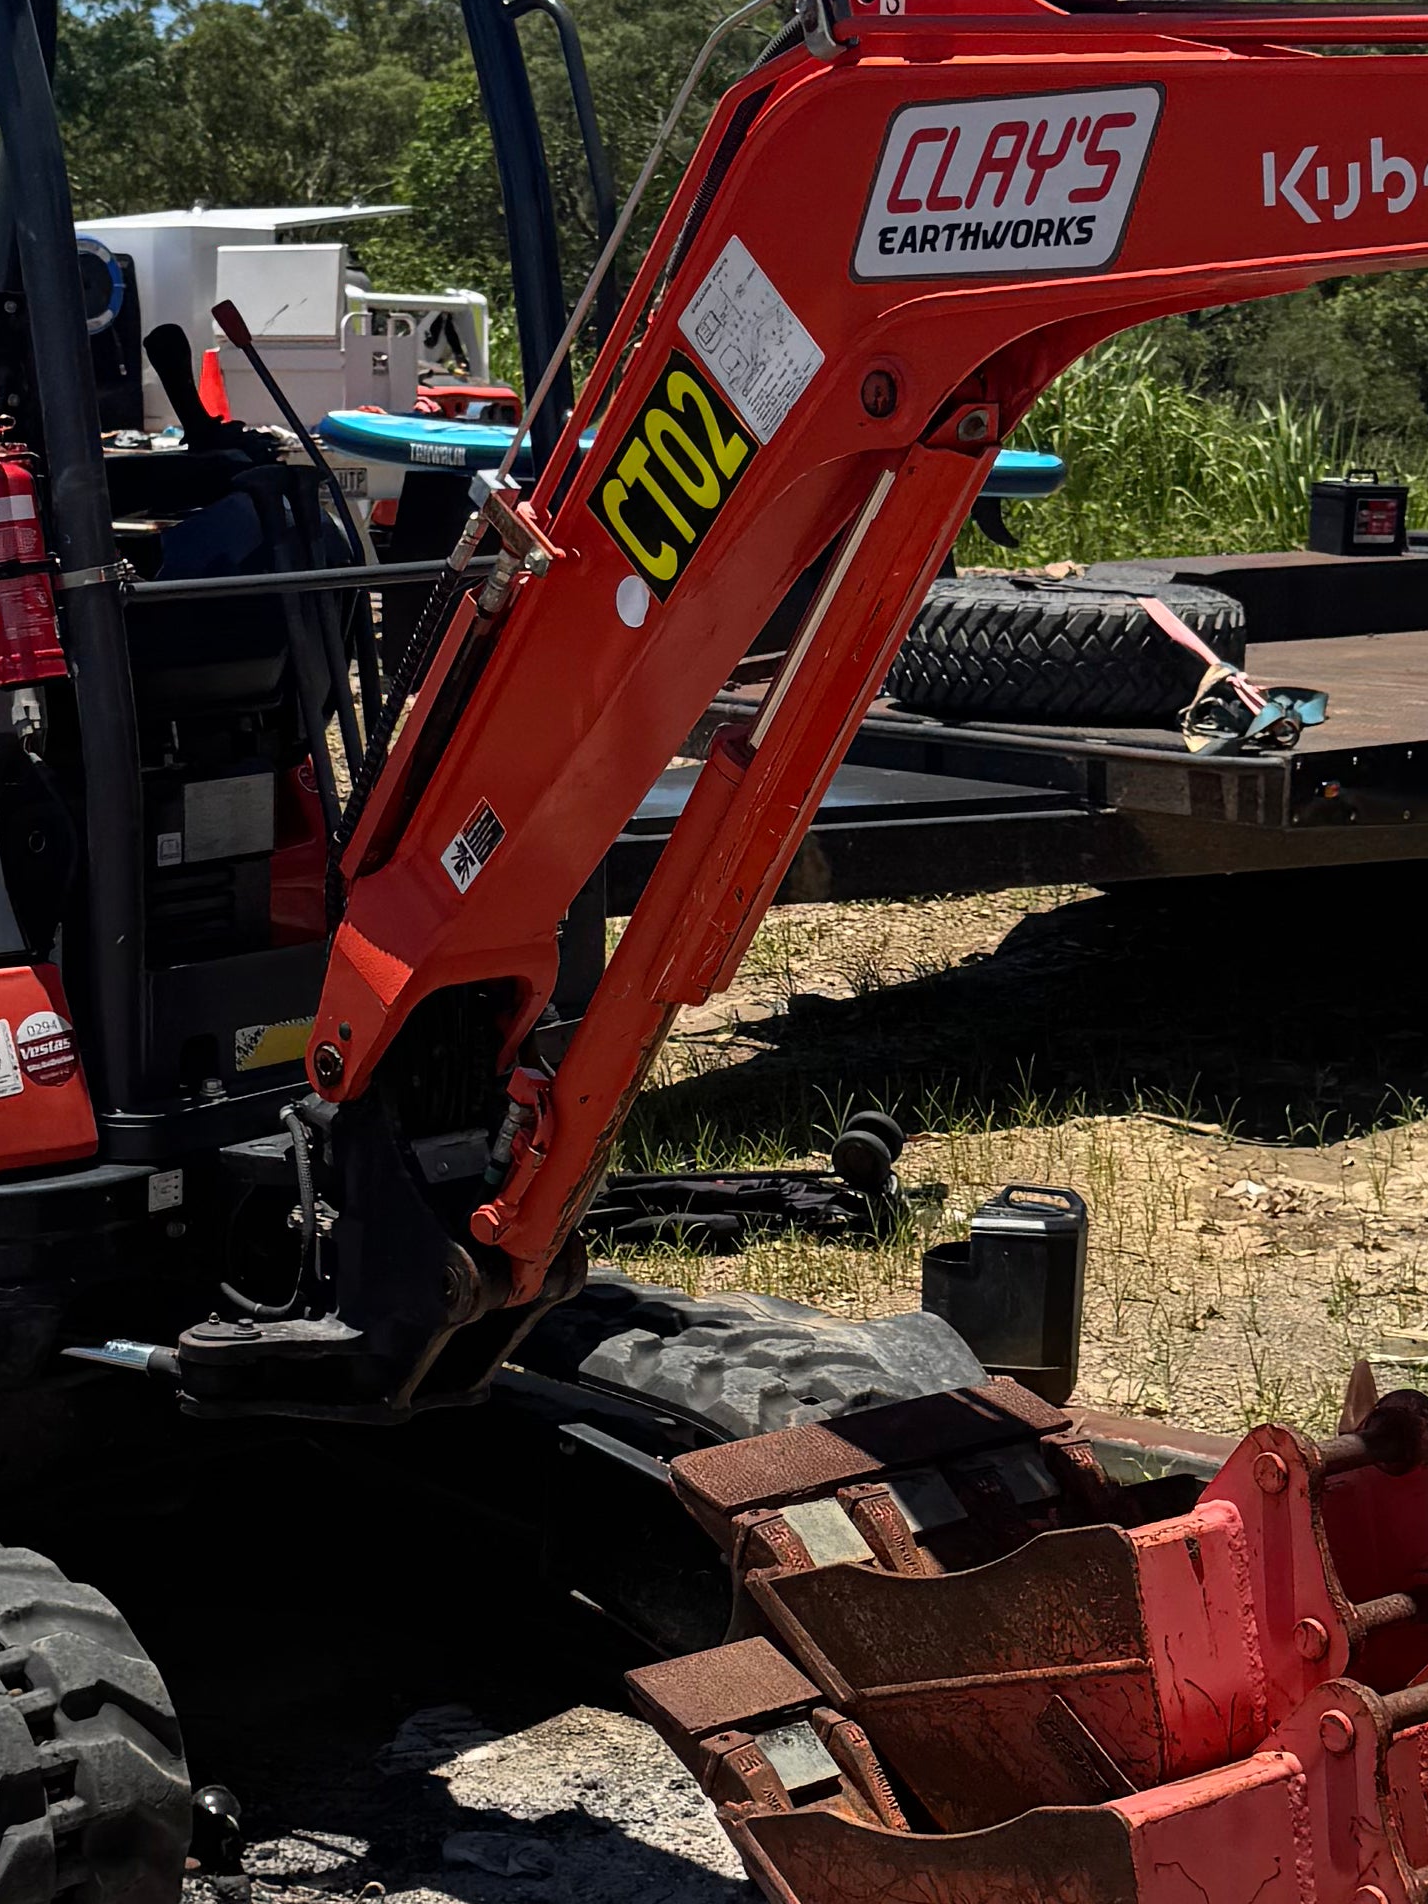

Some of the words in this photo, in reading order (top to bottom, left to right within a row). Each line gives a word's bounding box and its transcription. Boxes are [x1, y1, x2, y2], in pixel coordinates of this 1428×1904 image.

[886, 112, 1137, 214] CLAY'S
[877, 215, 1097, 255] EARTHWORKS
[602, 371, 749, 580] CT02
[20, 1038, 71, 1061] Vestas
